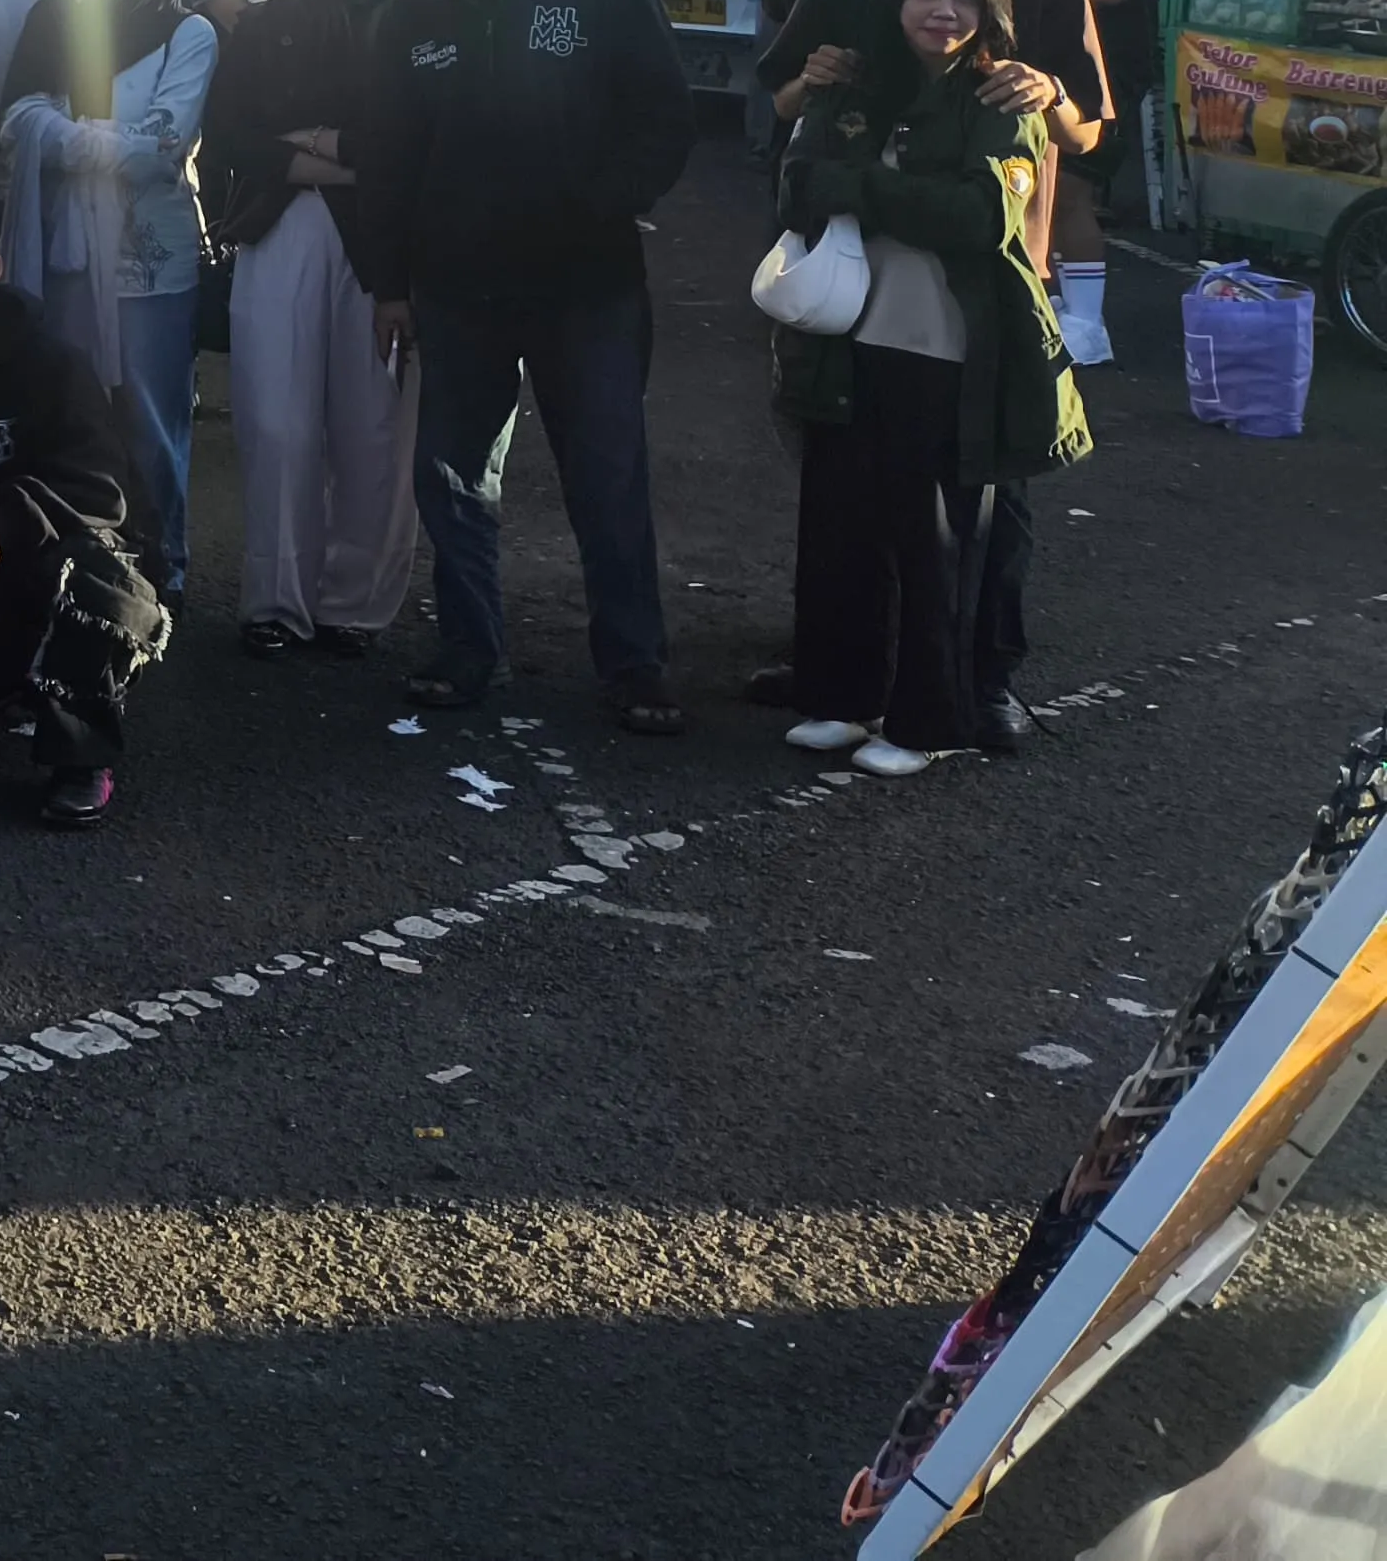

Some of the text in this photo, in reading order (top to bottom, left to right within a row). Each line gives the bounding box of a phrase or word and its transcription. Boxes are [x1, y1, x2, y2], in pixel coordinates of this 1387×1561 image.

[1199, 40, 1259, 69] Telor
[1186, 63, 1269, 103] Gulung
[1285, 58, 1387, 101] Basreng
